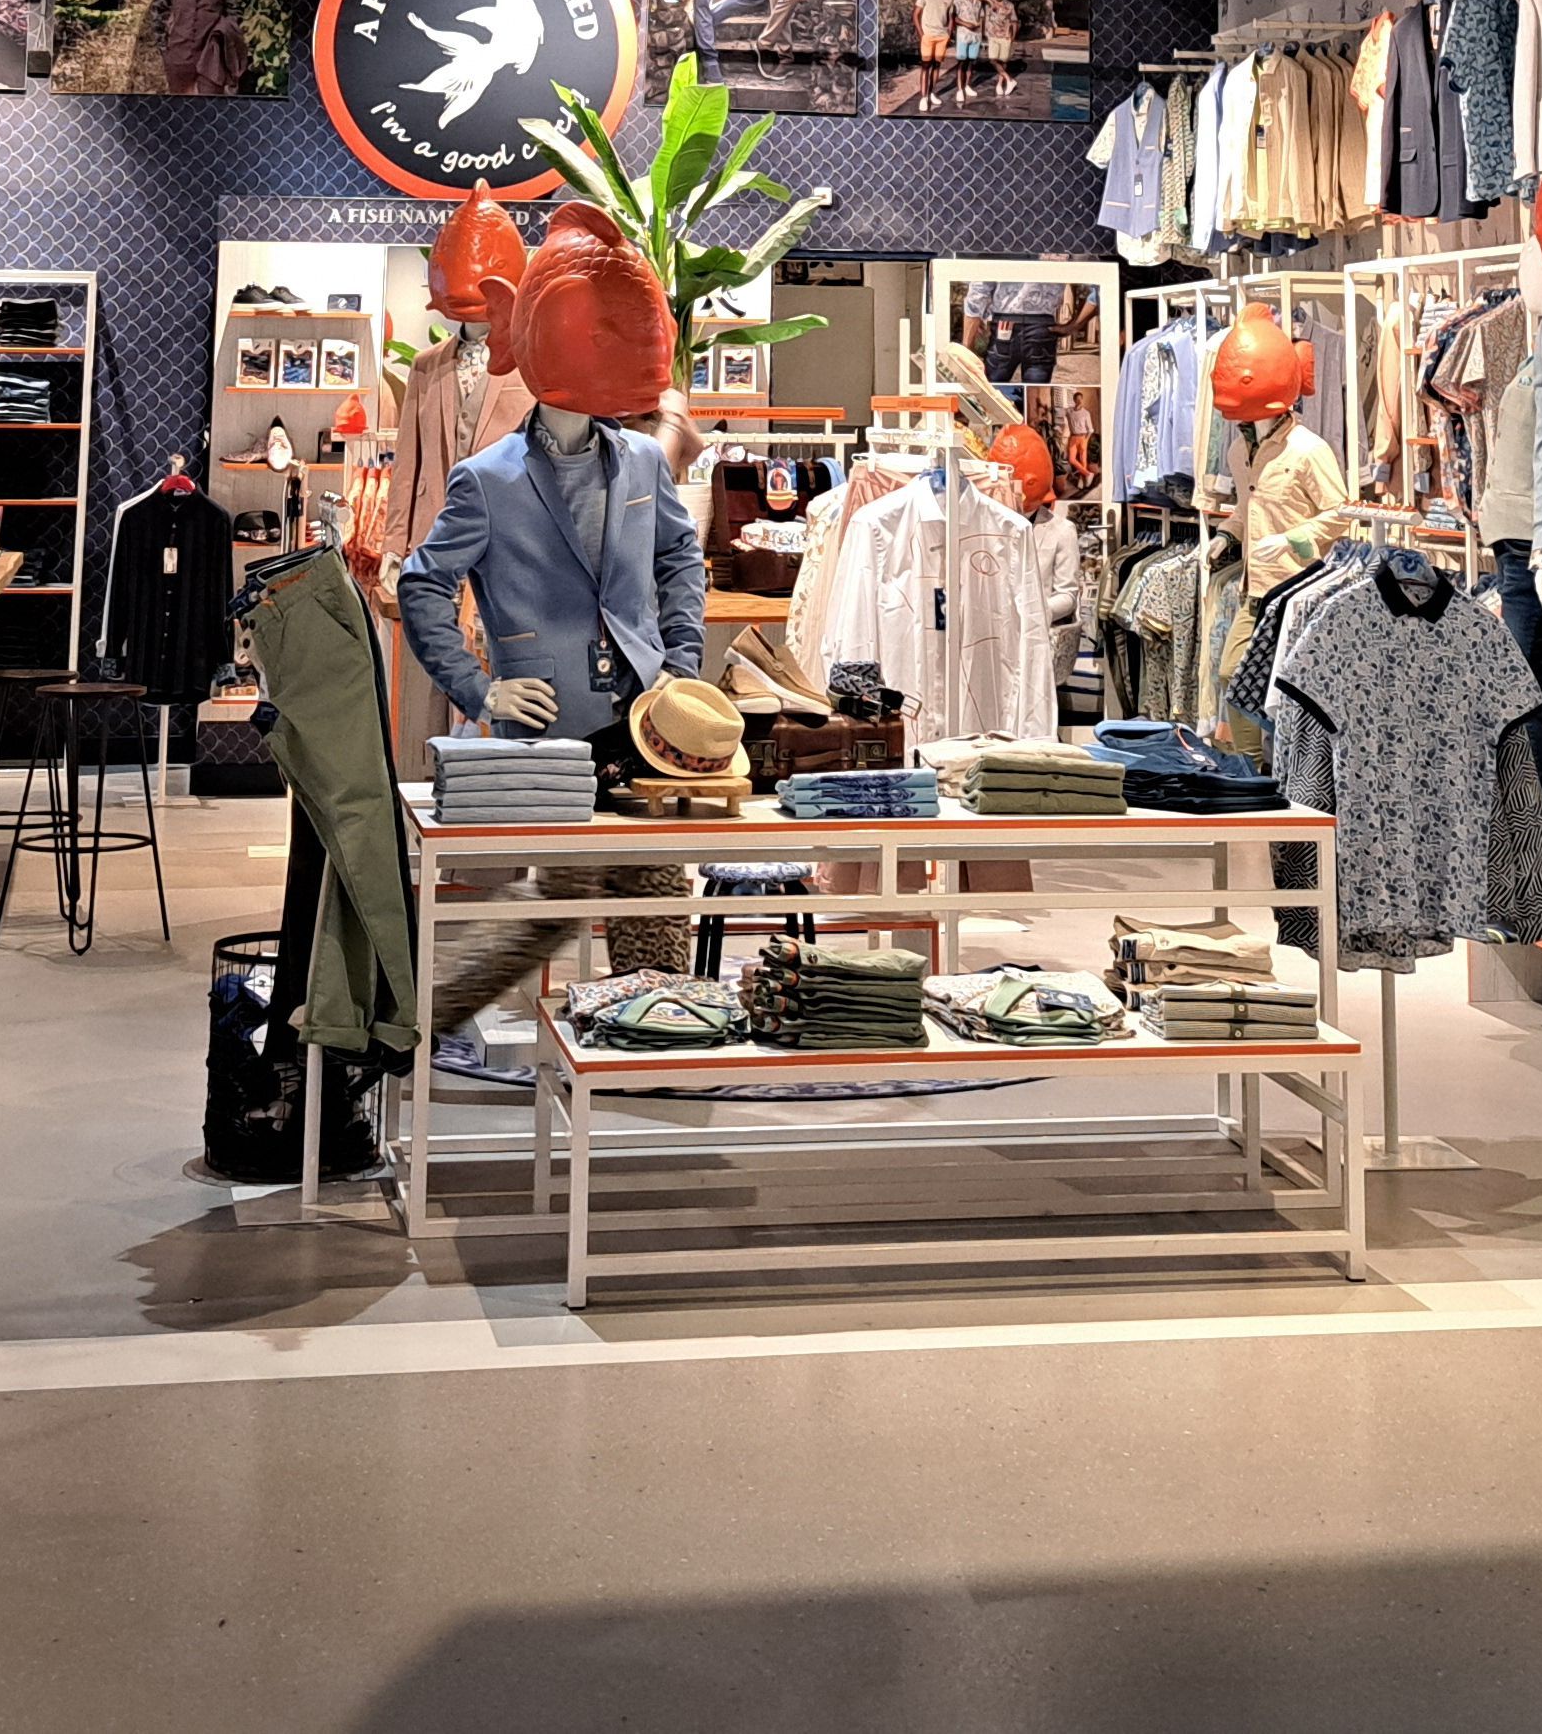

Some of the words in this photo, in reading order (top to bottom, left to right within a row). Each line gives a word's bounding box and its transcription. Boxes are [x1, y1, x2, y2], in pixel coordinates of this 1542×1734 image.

[353, 22, 380, 45] A
[370, 100, 412, 144] I'm
[414, 141, 439, 158] a
[441, 144, 516, 173] good
[327, 208, 342, 224] A
[348, 208, 393, 225] FISH
